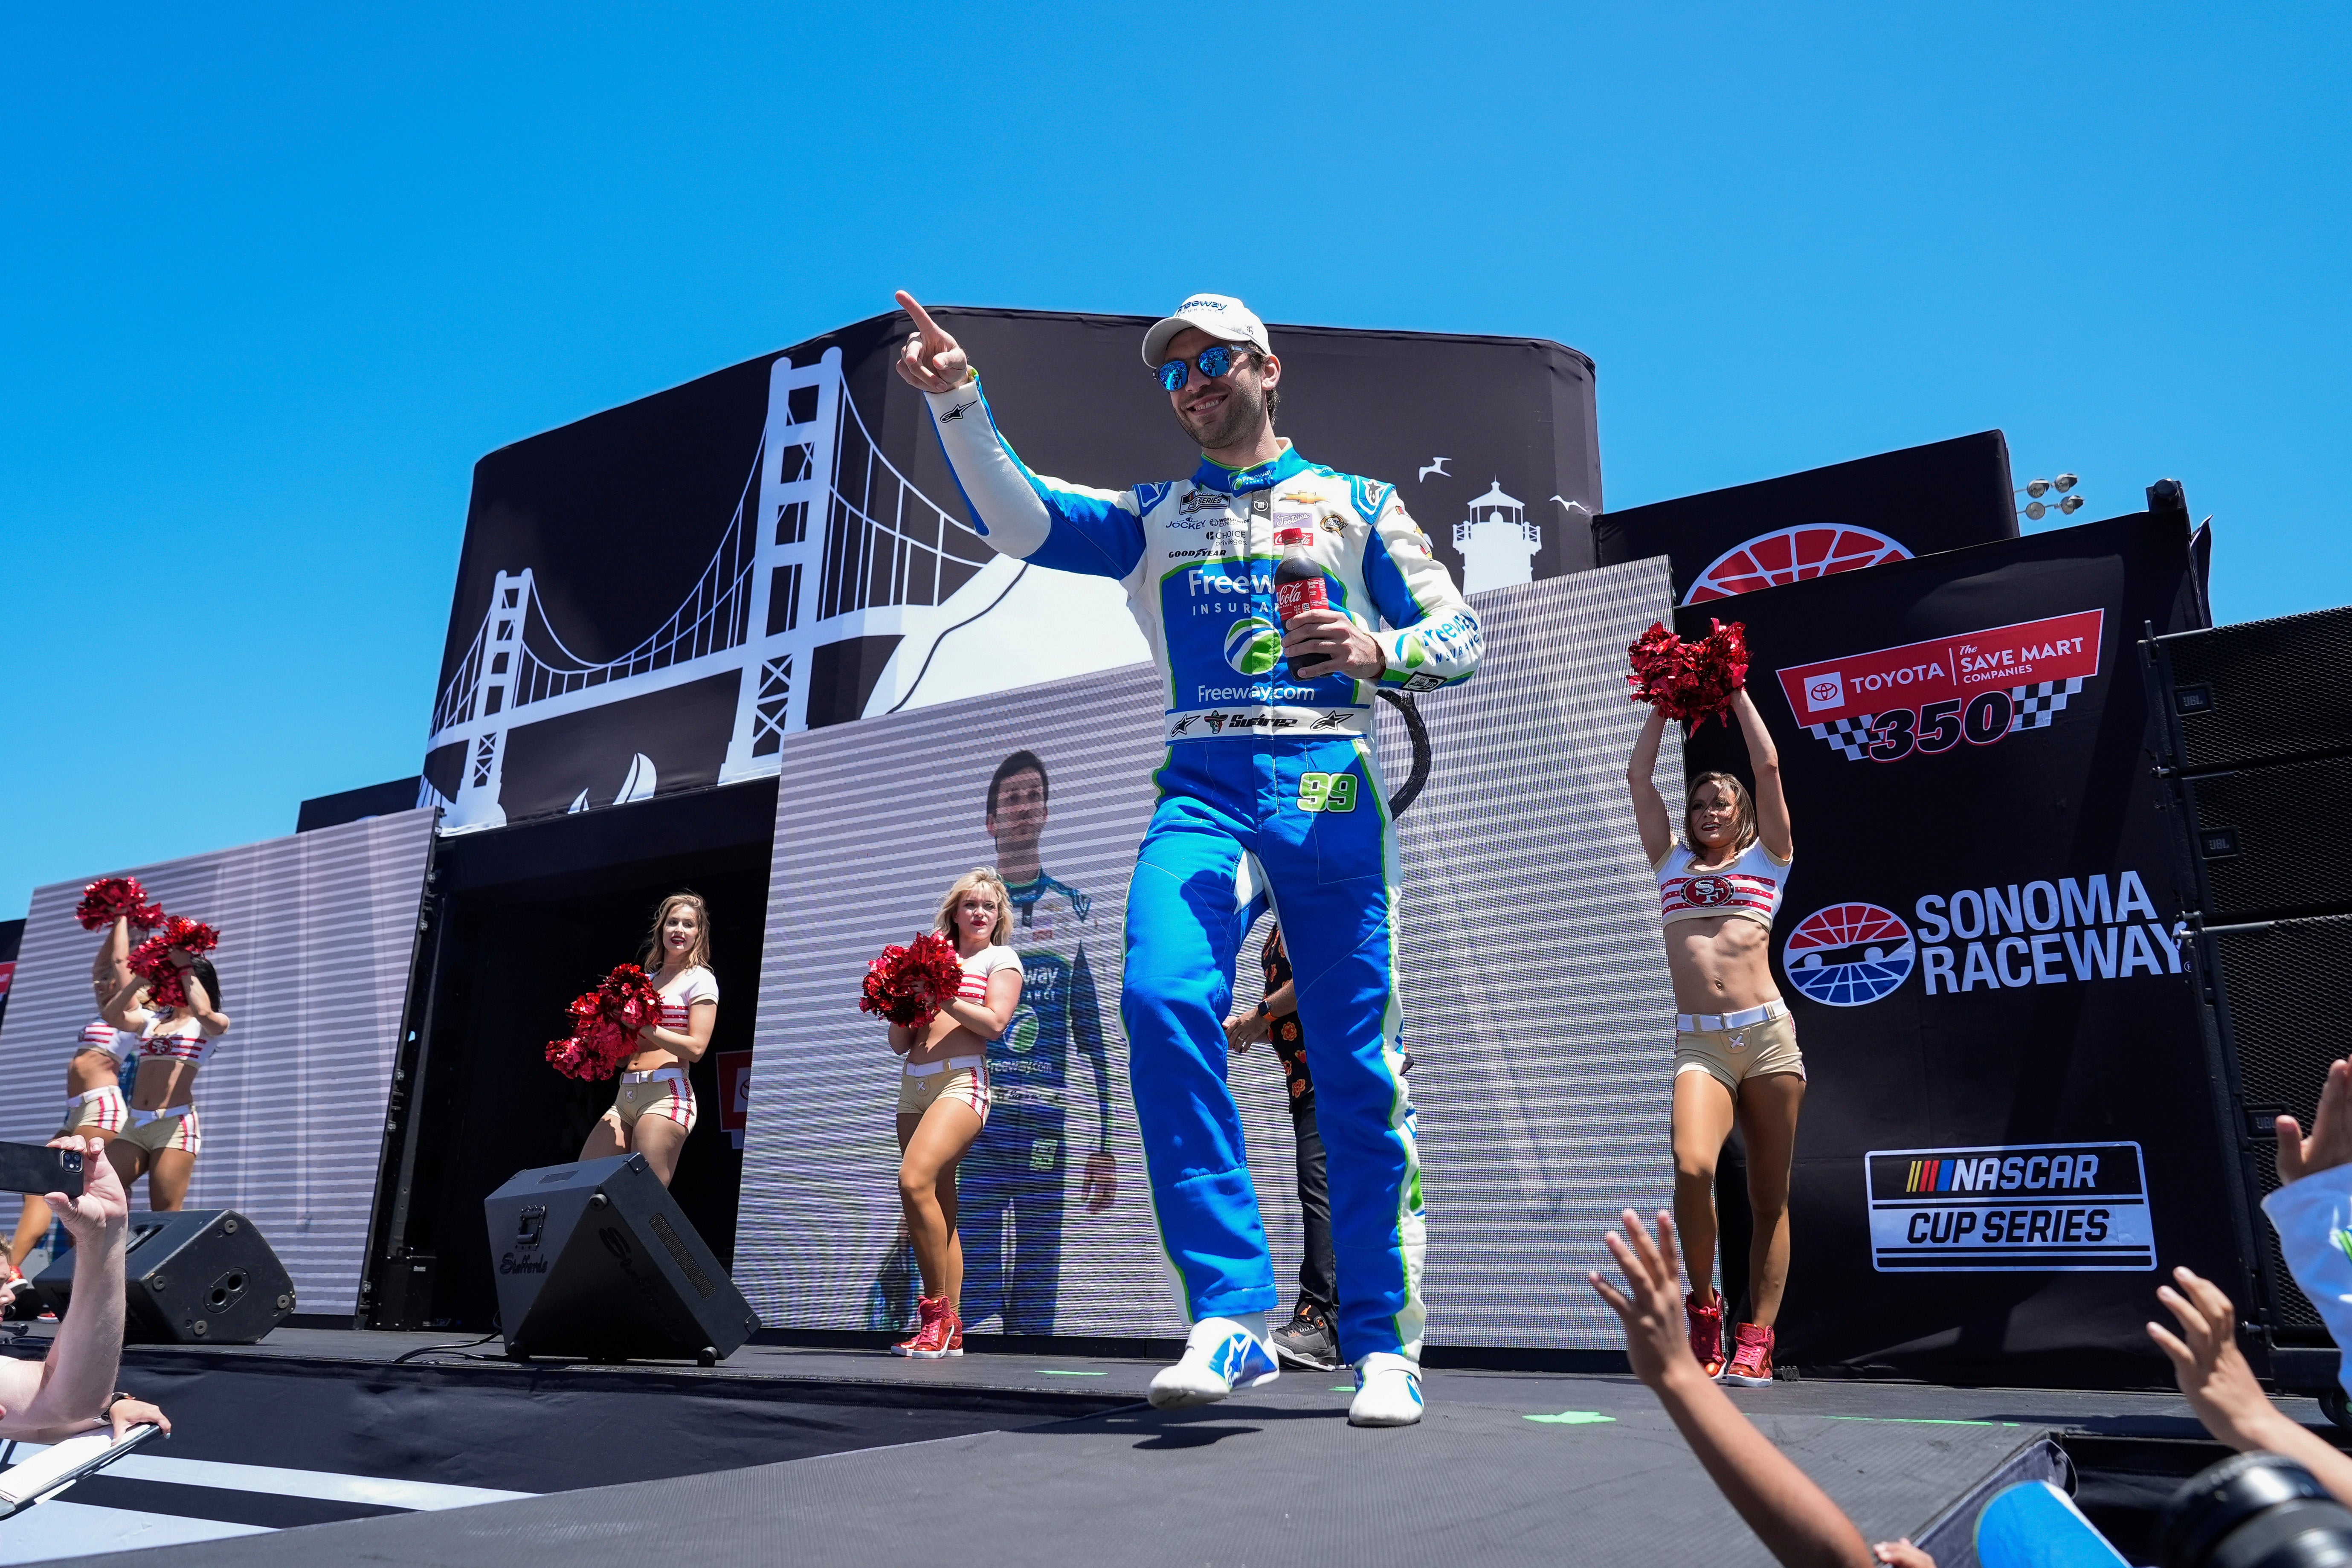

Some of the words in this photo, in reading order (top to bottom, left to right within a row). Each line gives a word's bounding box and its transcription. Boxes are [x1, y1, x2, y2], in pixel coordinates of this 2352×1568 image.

[1242, 470, 1272, 482] Freeway
[1243, 476, 1273, 486] INSURANCE
[1188, 499, 1198, 509] CUP
[1166, 519, 1206, 530] JOCKEY
[1276, 514, 1310, 526] Tootsies
[1215, 530, 1246, 539] CHOICE
[1169, 548, 1227, 558] GOODYEAR
[1188, 570, 1275, 597] Freew
[1429, 634, 1479, 665] INSURANC
[1960, 644, 1978, 655] The
[1961, 649, 2013, 673] SAVE
[2021, 637, 2084, 662] MART
[1850, 662, 1945, 694] TOYOTA
[1963, 664, 2033, 684] COMPANIES
[1198, 684, 1315, 703] Freeway.com
[2183, 695, 2204, 706] JBL
[1228, 713, 1298, 727] Suárez
[1869, 690, 2014, 762] 350
[1296, 772, 1359, 812] 99
[2209, 837, 2230, 850] JBL
[1916, 871, 2158, 944] SONOMA
[1923, 921, 2187, 996] RACEWAY
[1951, 1154, 2098, 1192] NASCAR
[1907, 1212, 1976, 1244] CUP
[1982, 1209, 2110, 1243] SERIES
